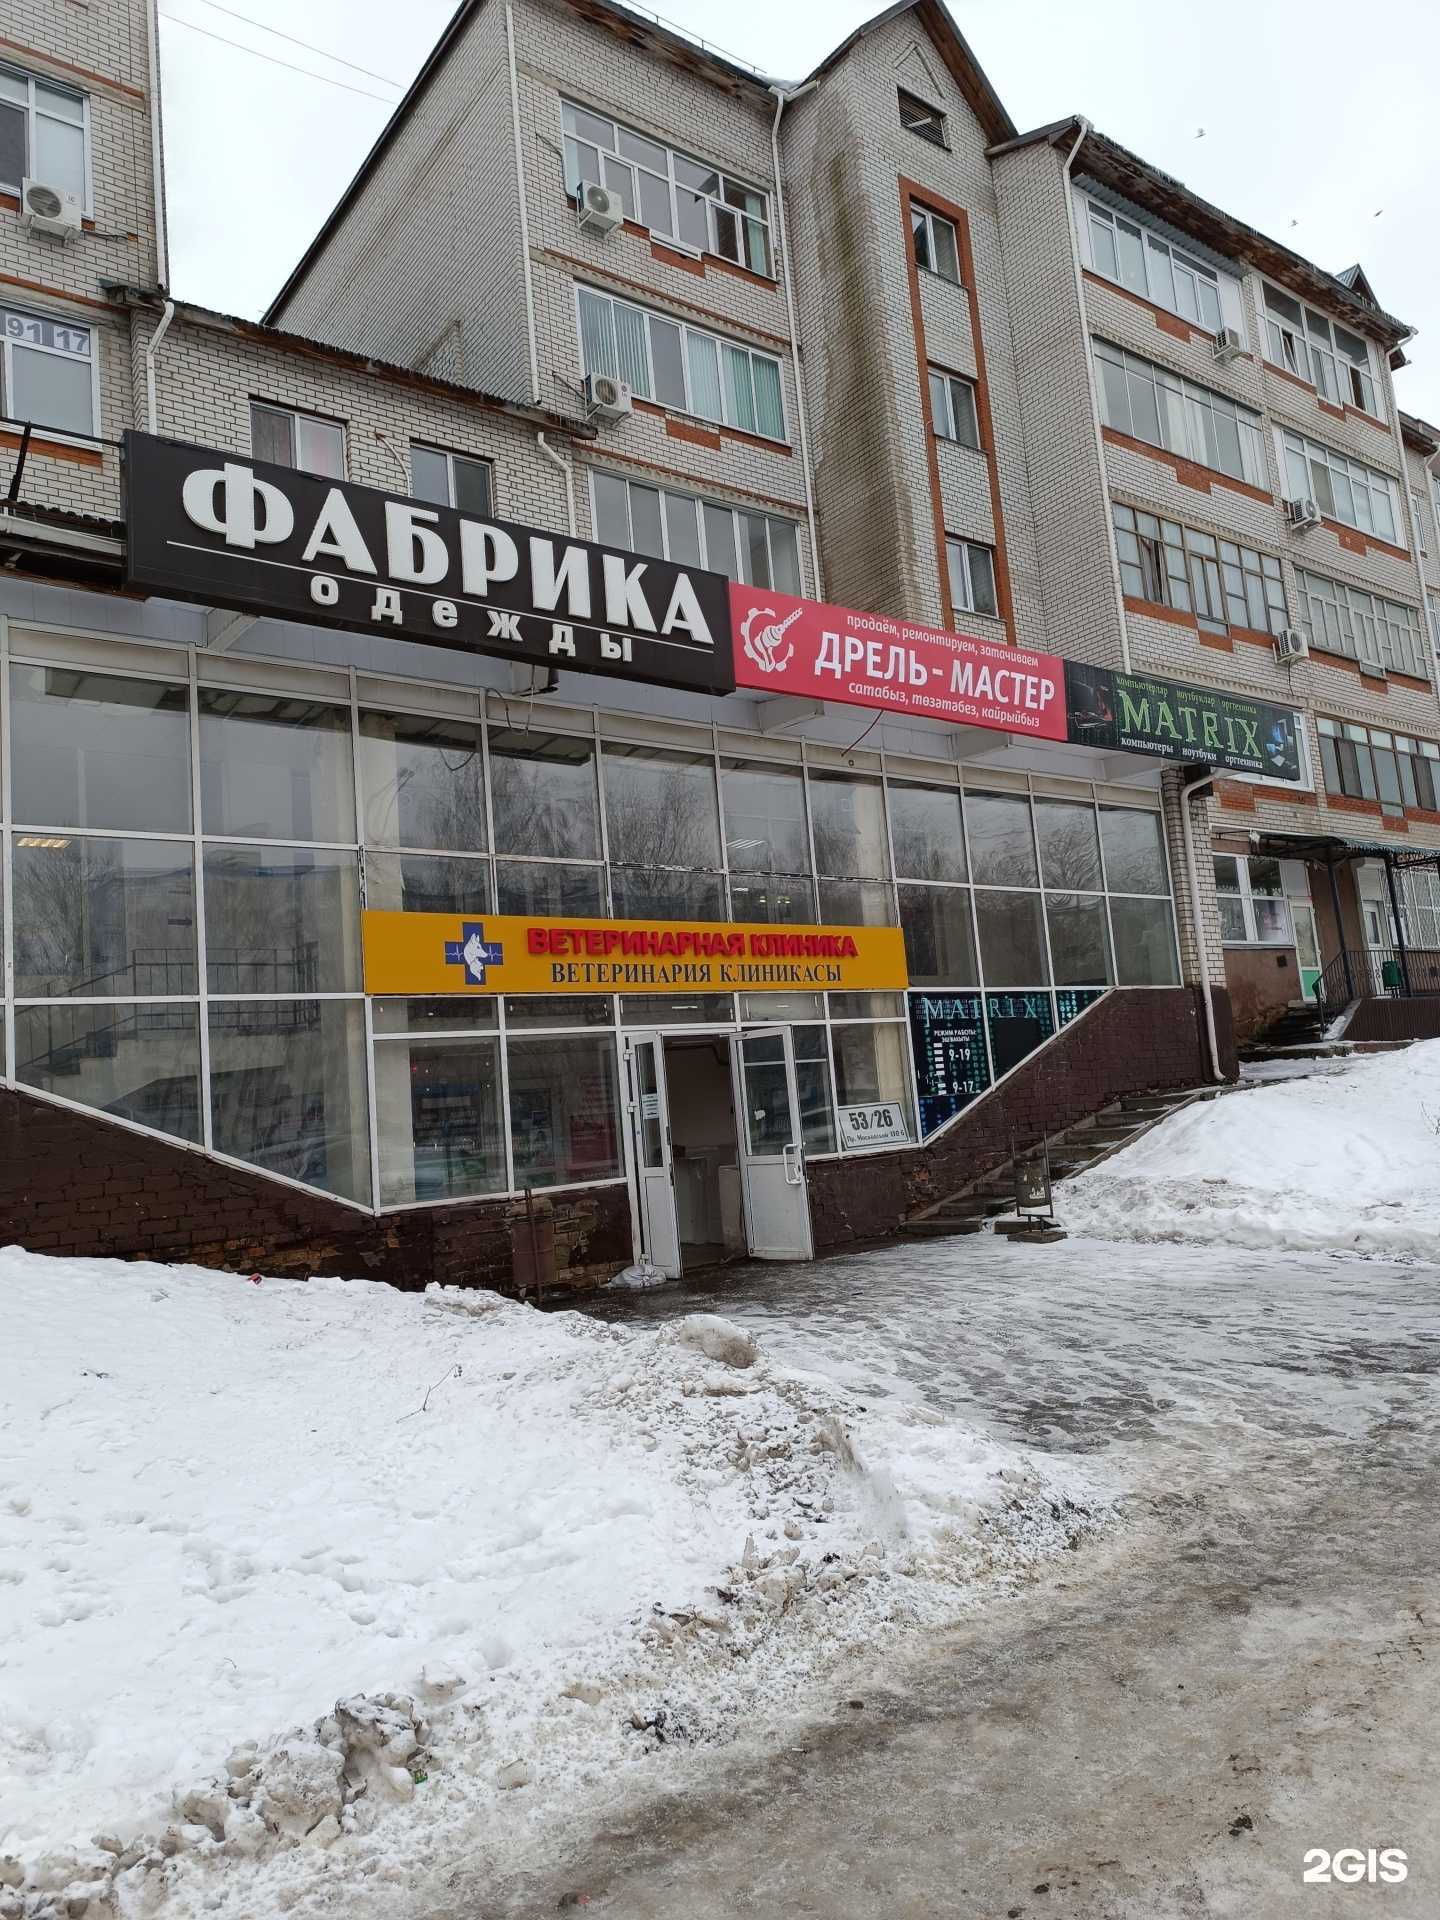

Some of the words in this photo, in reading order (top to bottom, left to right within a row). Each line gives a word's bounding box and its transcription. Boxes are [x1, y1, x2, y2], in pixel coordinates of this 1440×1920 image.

[8, 317, 40, 344] 91
[57, 330, 88, 351] 17
[182, 463, 713, 644] ФАБРИКА
[309, 576, 633, 662] одежды
[847, 615, 900, 638] продаём,
[902, 627, 978, 656] ремонтируем,
[980, 645, 1038, 667] затачиваем
[950, 659, 1055, 710] МАСТЕР
[848, 682, 908, 705] сатабыз,
[981, 706, 1040, 727] кайрыйбыз
[1117, 689, 1262, 758] MATRIX
[1121, 737, 1174, 754] компьютеры
[1182, 747, 1217, 761] ноутбуки
[1225, 755, 1263, 769] оргтехника
[527, 928, 746, 956] ВЕТЕРИНАРНАЯ
[750, 934, 859, 957] КЛИНИКА
[551, 963, 711, 983] ВЕТЕРИНАРИЯ
[720, 963, 841, 982] КЛИНИКАСЫ
[921, 998, 1037, 1027] MATRIX
[949, 1049, 970, 1061] 9-19
[953, 1081, 973, 1093] 9-17
[849, 1109, 893, 1130] 53/26
